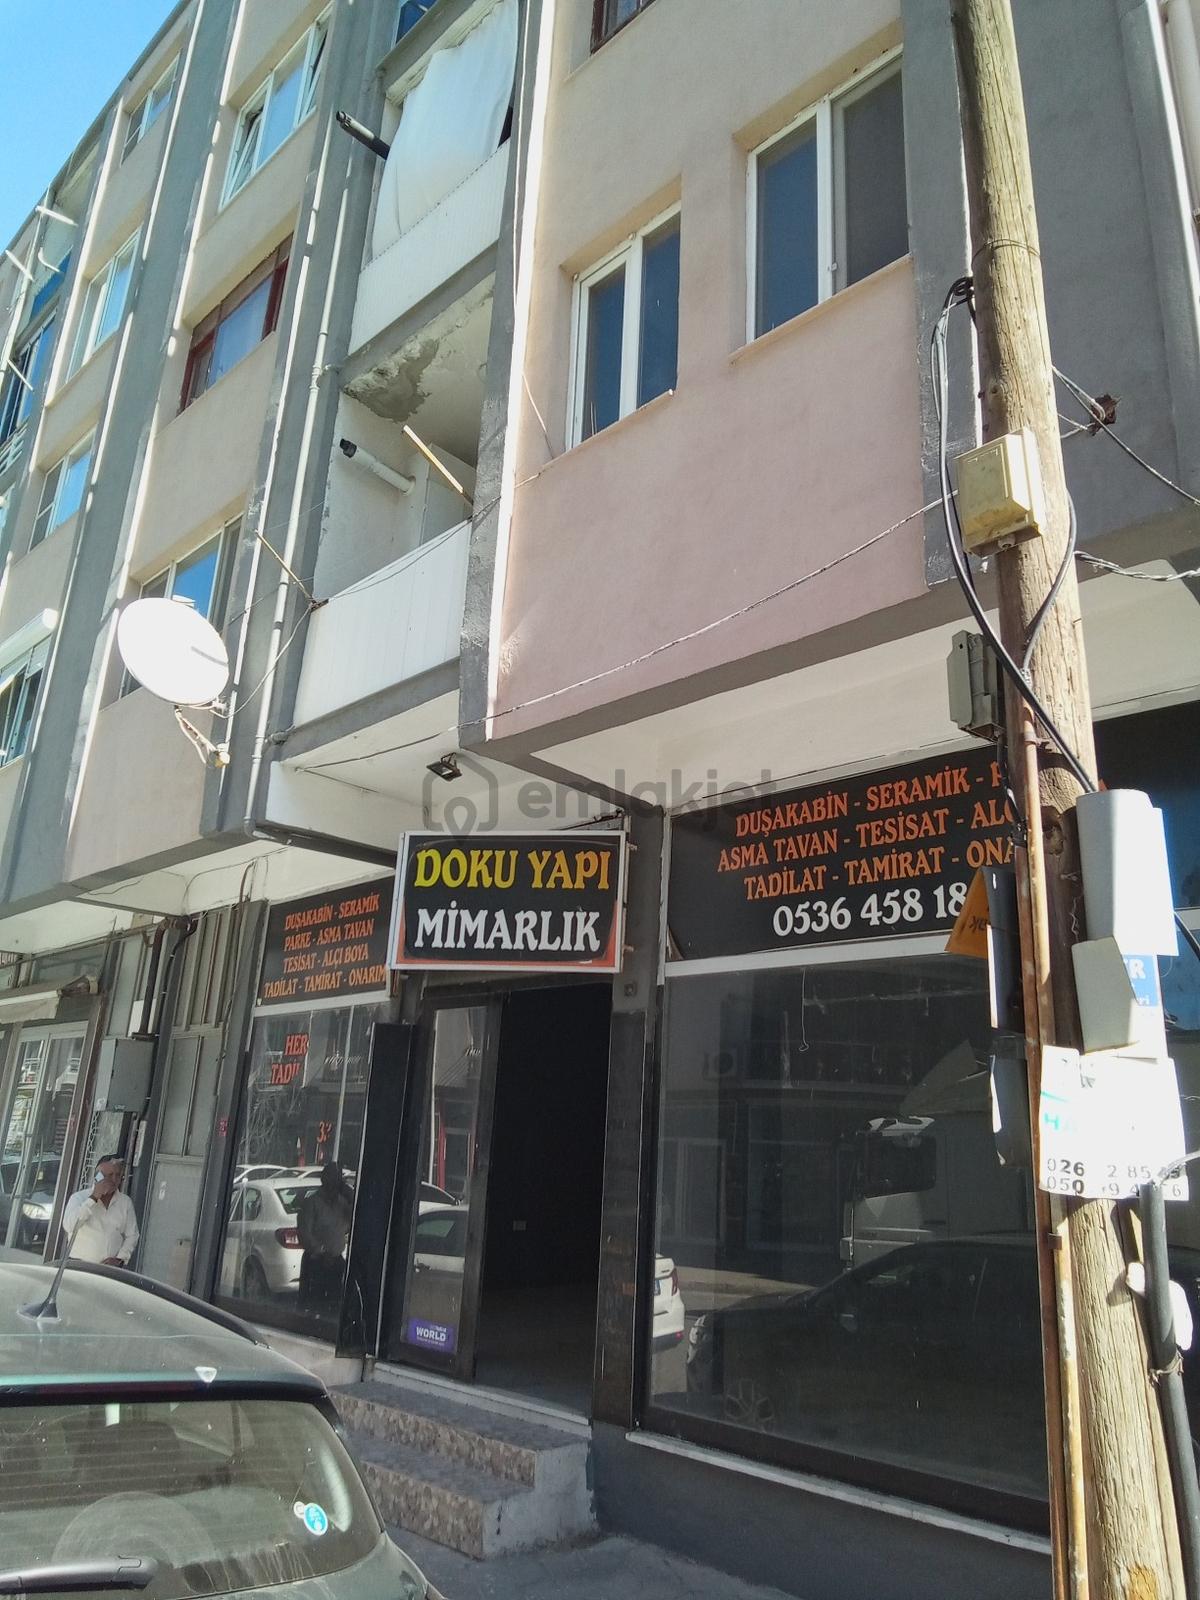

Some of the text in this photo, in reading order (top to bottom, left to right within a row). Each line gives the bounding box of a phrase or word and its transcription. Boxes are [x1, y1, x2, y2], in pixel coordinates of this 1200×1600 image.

[736, 790, 849, 838] DUŞAKABİN
[866, 765, 970, 812] SERAMİK
[717, 845, 769, 872] ASMA
[773, 829, 838, 860] TAVAN
[856, 808, 949, 848] TESİSAT
[413, 849, 611, 890] DOKU YAPI
[744, 865, 827, 900] TADİLAT
[844, 846, 945, 886] TAMİRAT
[284, 904, 333, 931] DUŞAKABİN
[339, 892, 380, 918] SERAMİK
[414, 900, 600, 951] MİMARLIK
[772, 897, 851, 936] 0536
[859, 888, 924, 927] 458
[284, 931, 312, 951] PARKE
[317, 926, 342, 945] ASMA
[344, 919, 375, 940] TAVAN
[283, 951, 317, 973] TESİSAT
[321, 947, 344, 968] ALÇI
[344, 942, 369, 963] BOYA
[264, 977, 298, 998] TADİLAT
[304, 970, 342, 992] TAMİRAT
[284, 1033, 309, 1056] HER
[416, 1326, 447, 1342] WORLD
